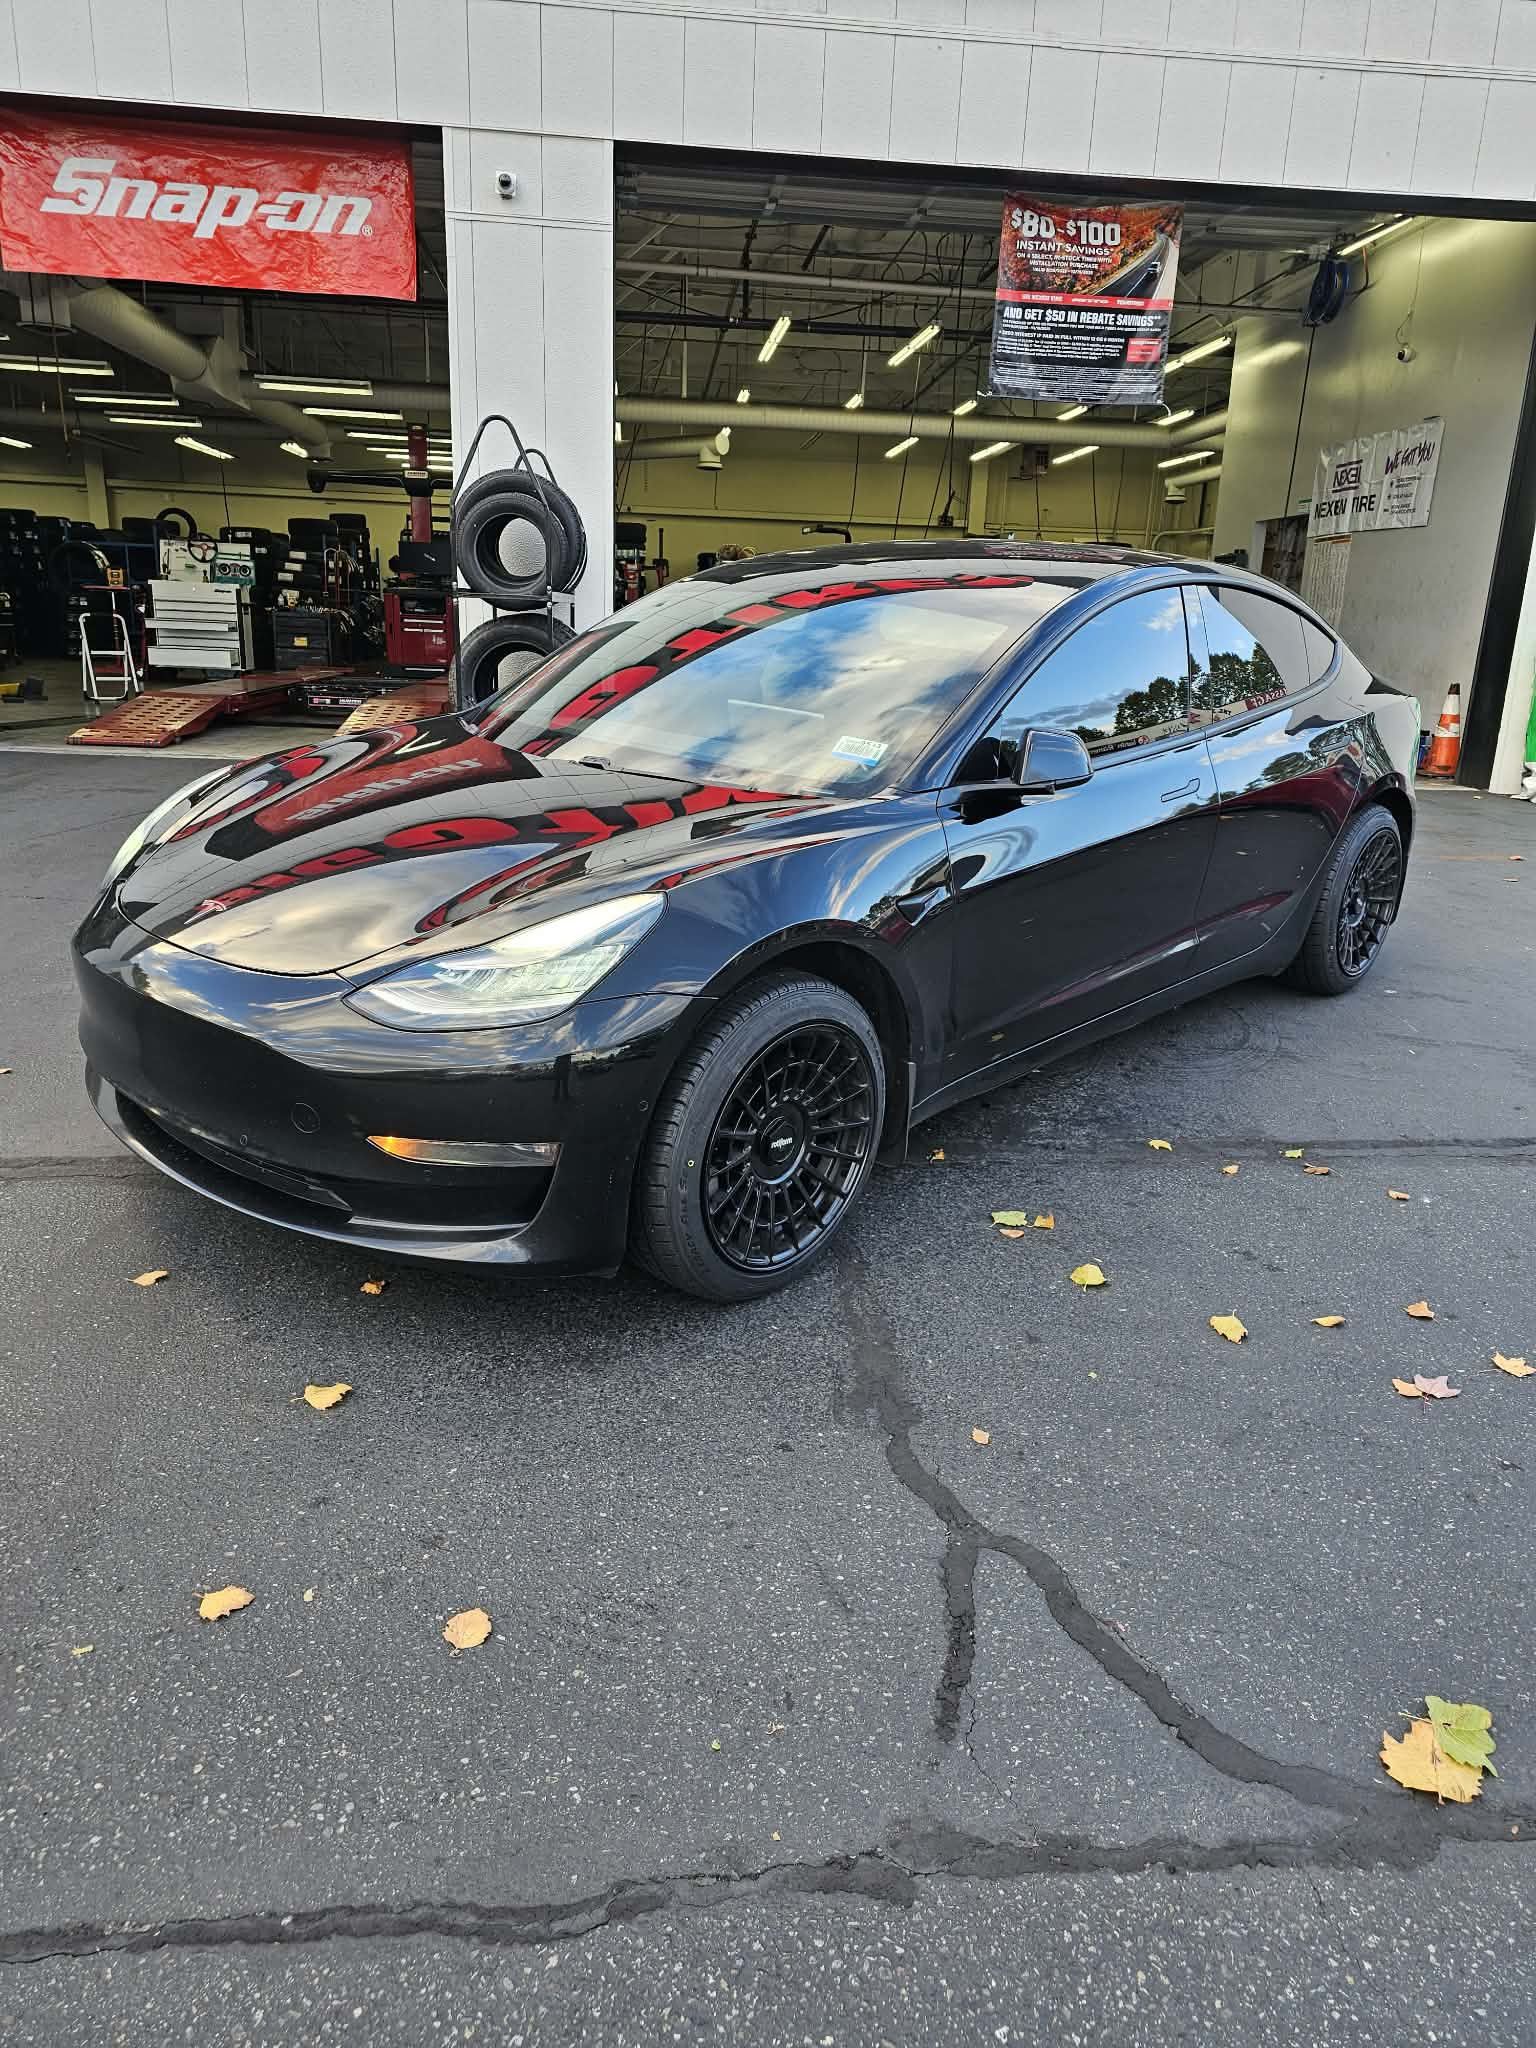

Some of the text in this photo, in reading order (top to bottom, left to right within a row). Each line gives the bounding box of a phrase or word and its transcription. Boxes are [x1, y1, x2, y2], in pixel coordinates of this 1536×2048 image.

[1016, 240, 1063, 252] INSTANT
[1003, 307, 1023, 319] AND
[1024, 308, 1044, 321] GET
[1045, 309, 1066, 322] $50
[1067, 311, 1079, 323] IN
[1080, 311, 1116, 325] REBATE
[1384, 440, 1436, 475] WE GOT YOU
[1314, 498, 1348, 520] NEXEN
